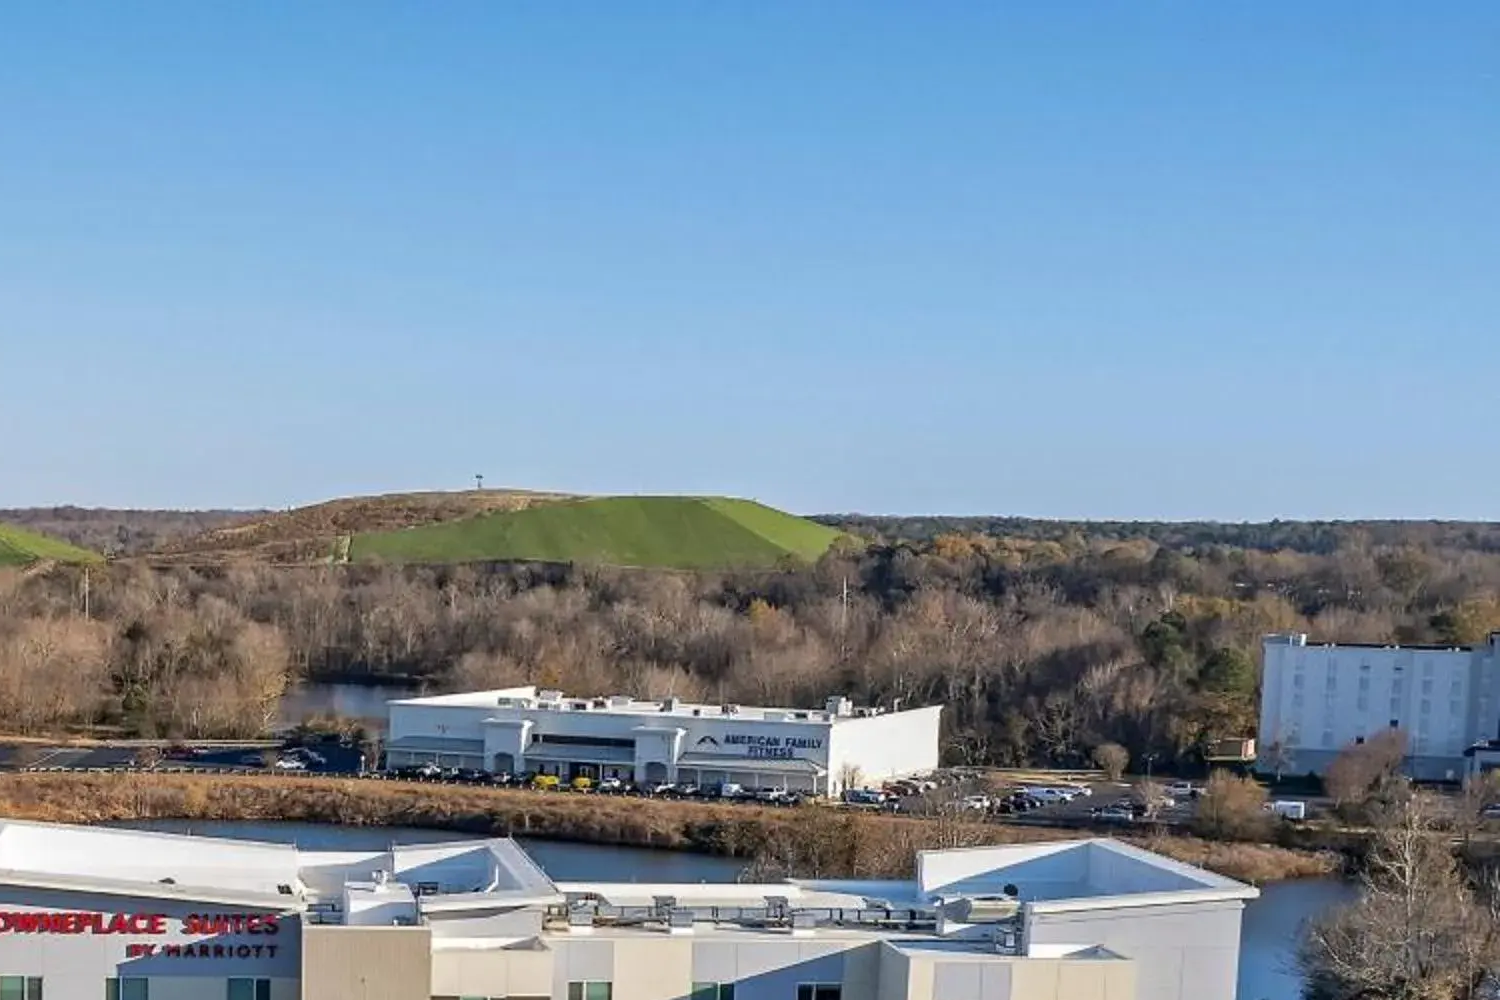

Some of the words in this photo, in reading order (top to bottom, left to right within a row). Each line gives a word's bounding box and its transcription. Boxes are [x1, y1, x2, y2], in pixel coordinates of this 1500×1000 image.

[724, 735, 780, 746] AMERICAN
[785, 737, 822, 748] FAMILY
[748, 746, 793, 757] FITNESS
[182, 912, 279, 935] SUITES
[126, 944, 157, 958] BY
[163, 944, 278, 958] MARRIOTT
